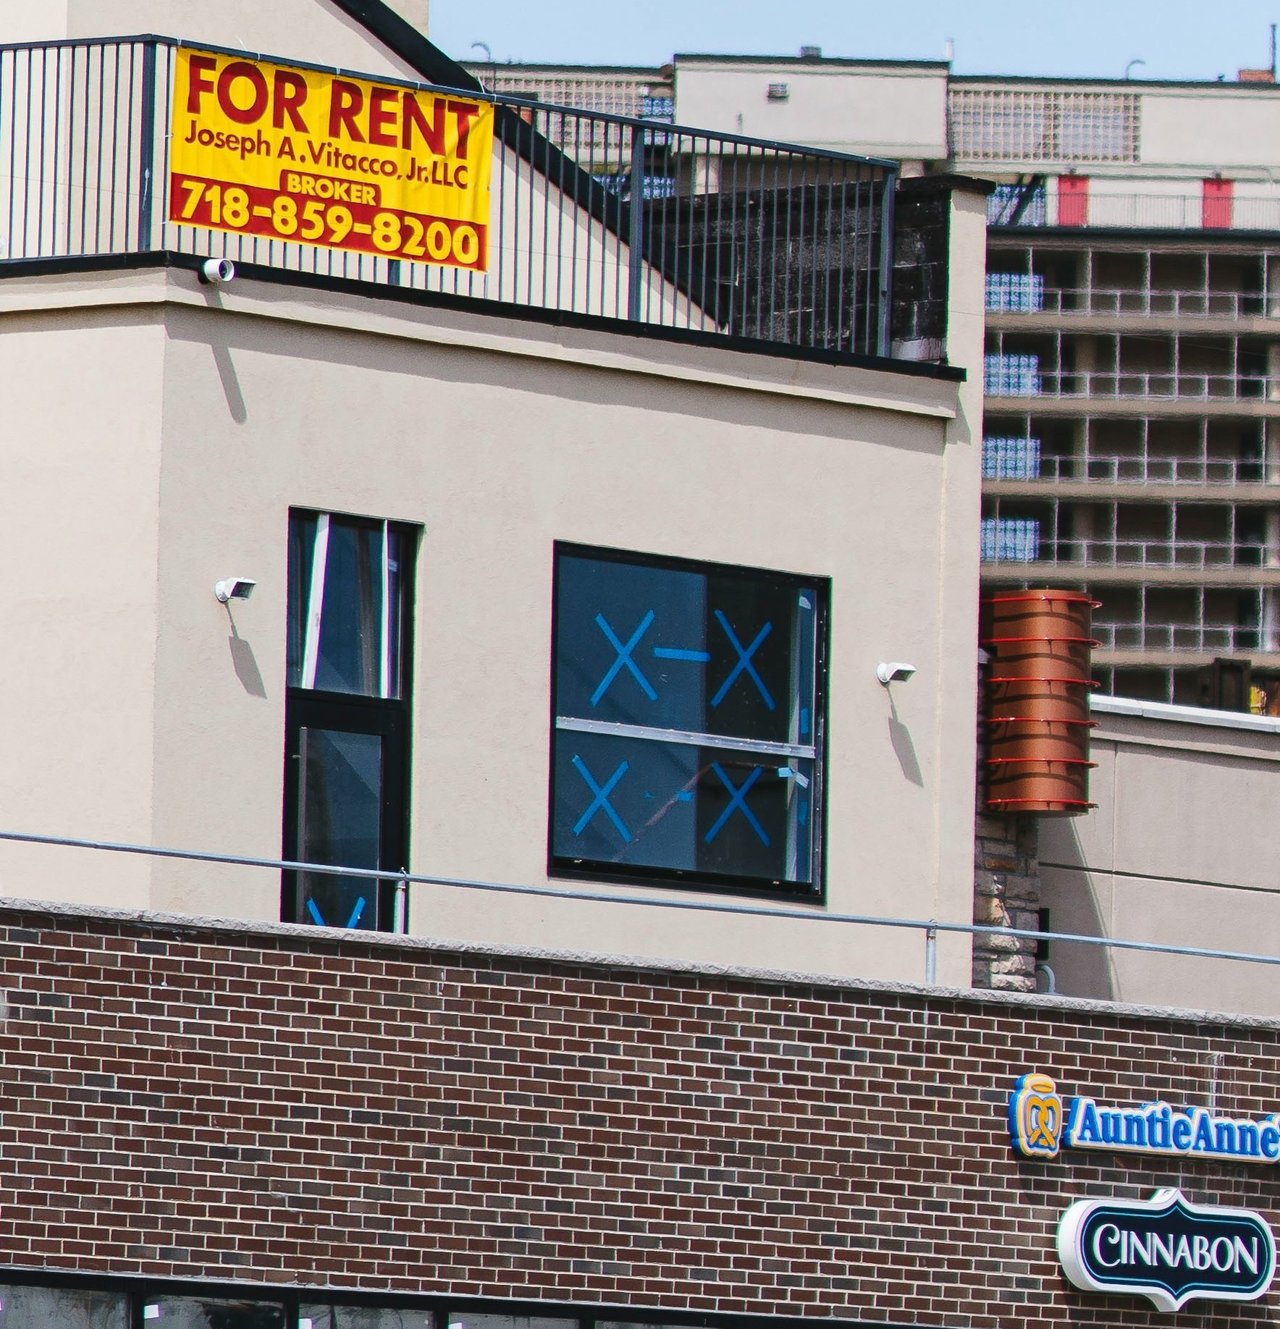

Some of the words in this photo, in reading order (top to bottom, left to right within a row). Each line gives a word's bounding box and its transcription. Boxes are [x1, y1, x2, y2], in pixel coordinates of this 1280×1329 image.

[187, 54, 310, 134] FOR
[329, 79, 480, 160] RENT
[185, 120, 271, 160] Joseph
[287, 173, 377, 206] BROKER
[181, 180, 480, 264] 718-859-8200
[1092, 1223, 1259, 1275] CINNABON
